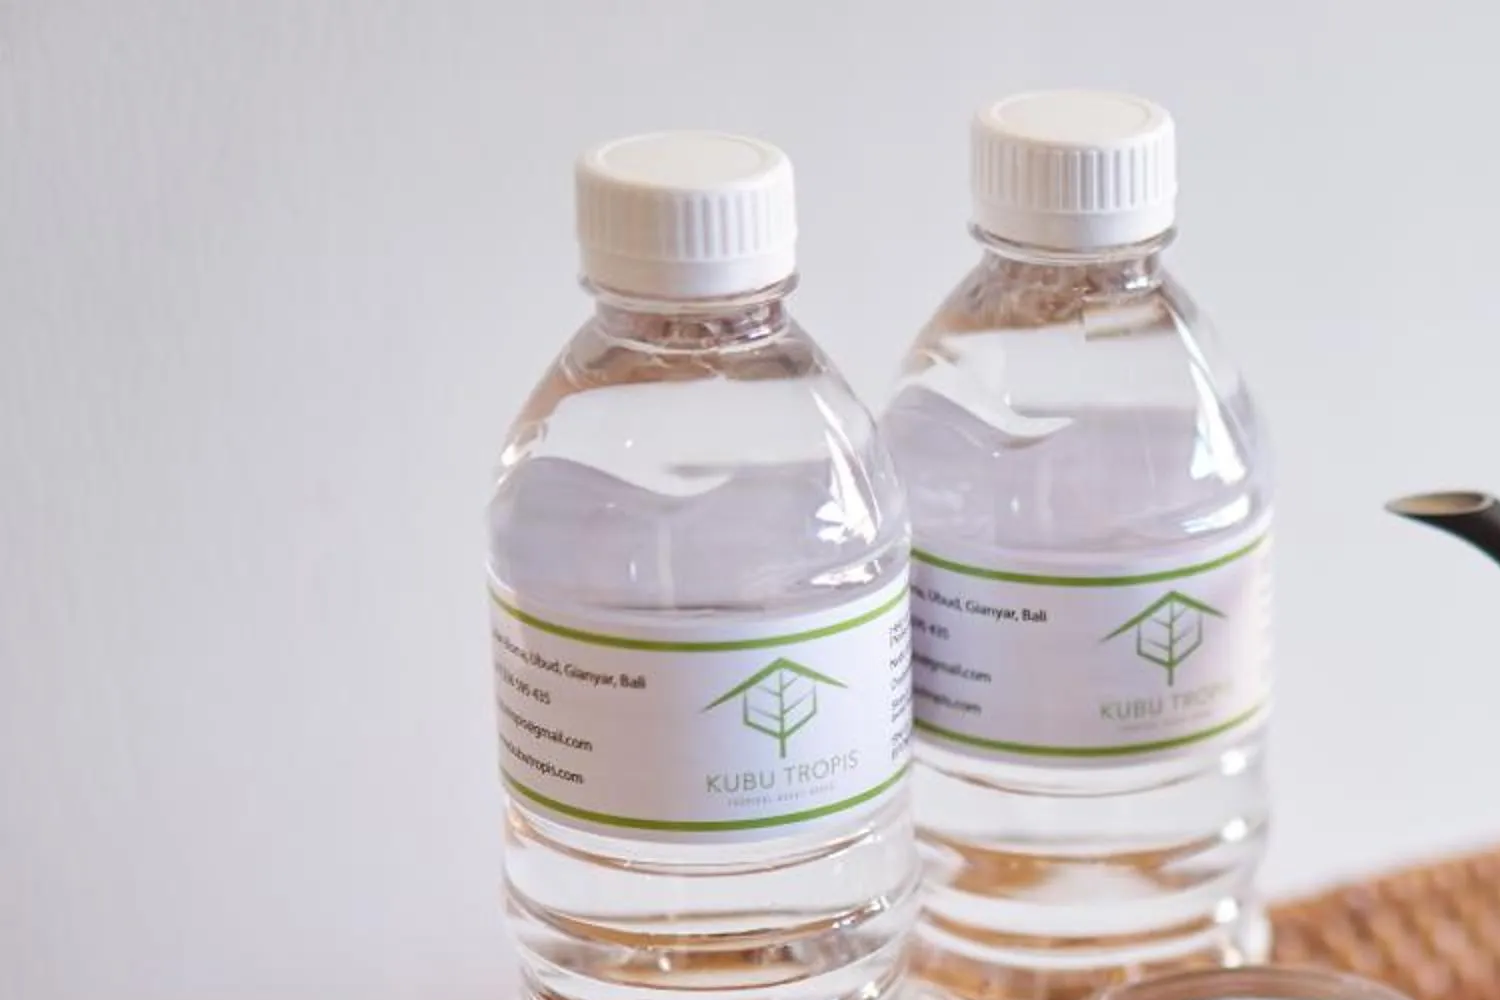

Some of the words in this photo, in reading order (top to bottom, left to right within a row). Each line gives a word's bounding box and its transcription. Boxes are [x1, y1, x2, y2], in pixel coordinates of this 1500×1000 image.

[1021, 607, 1047, 622] Bali
[563, 663, 617, 689] Gianyar,
[620, 673, 646, 690] Bali
[1100, 697, 1163, 721] KUBU
[705, 771, 775, 794] KUBU
[783, 749, 859, 787] TROPIS
